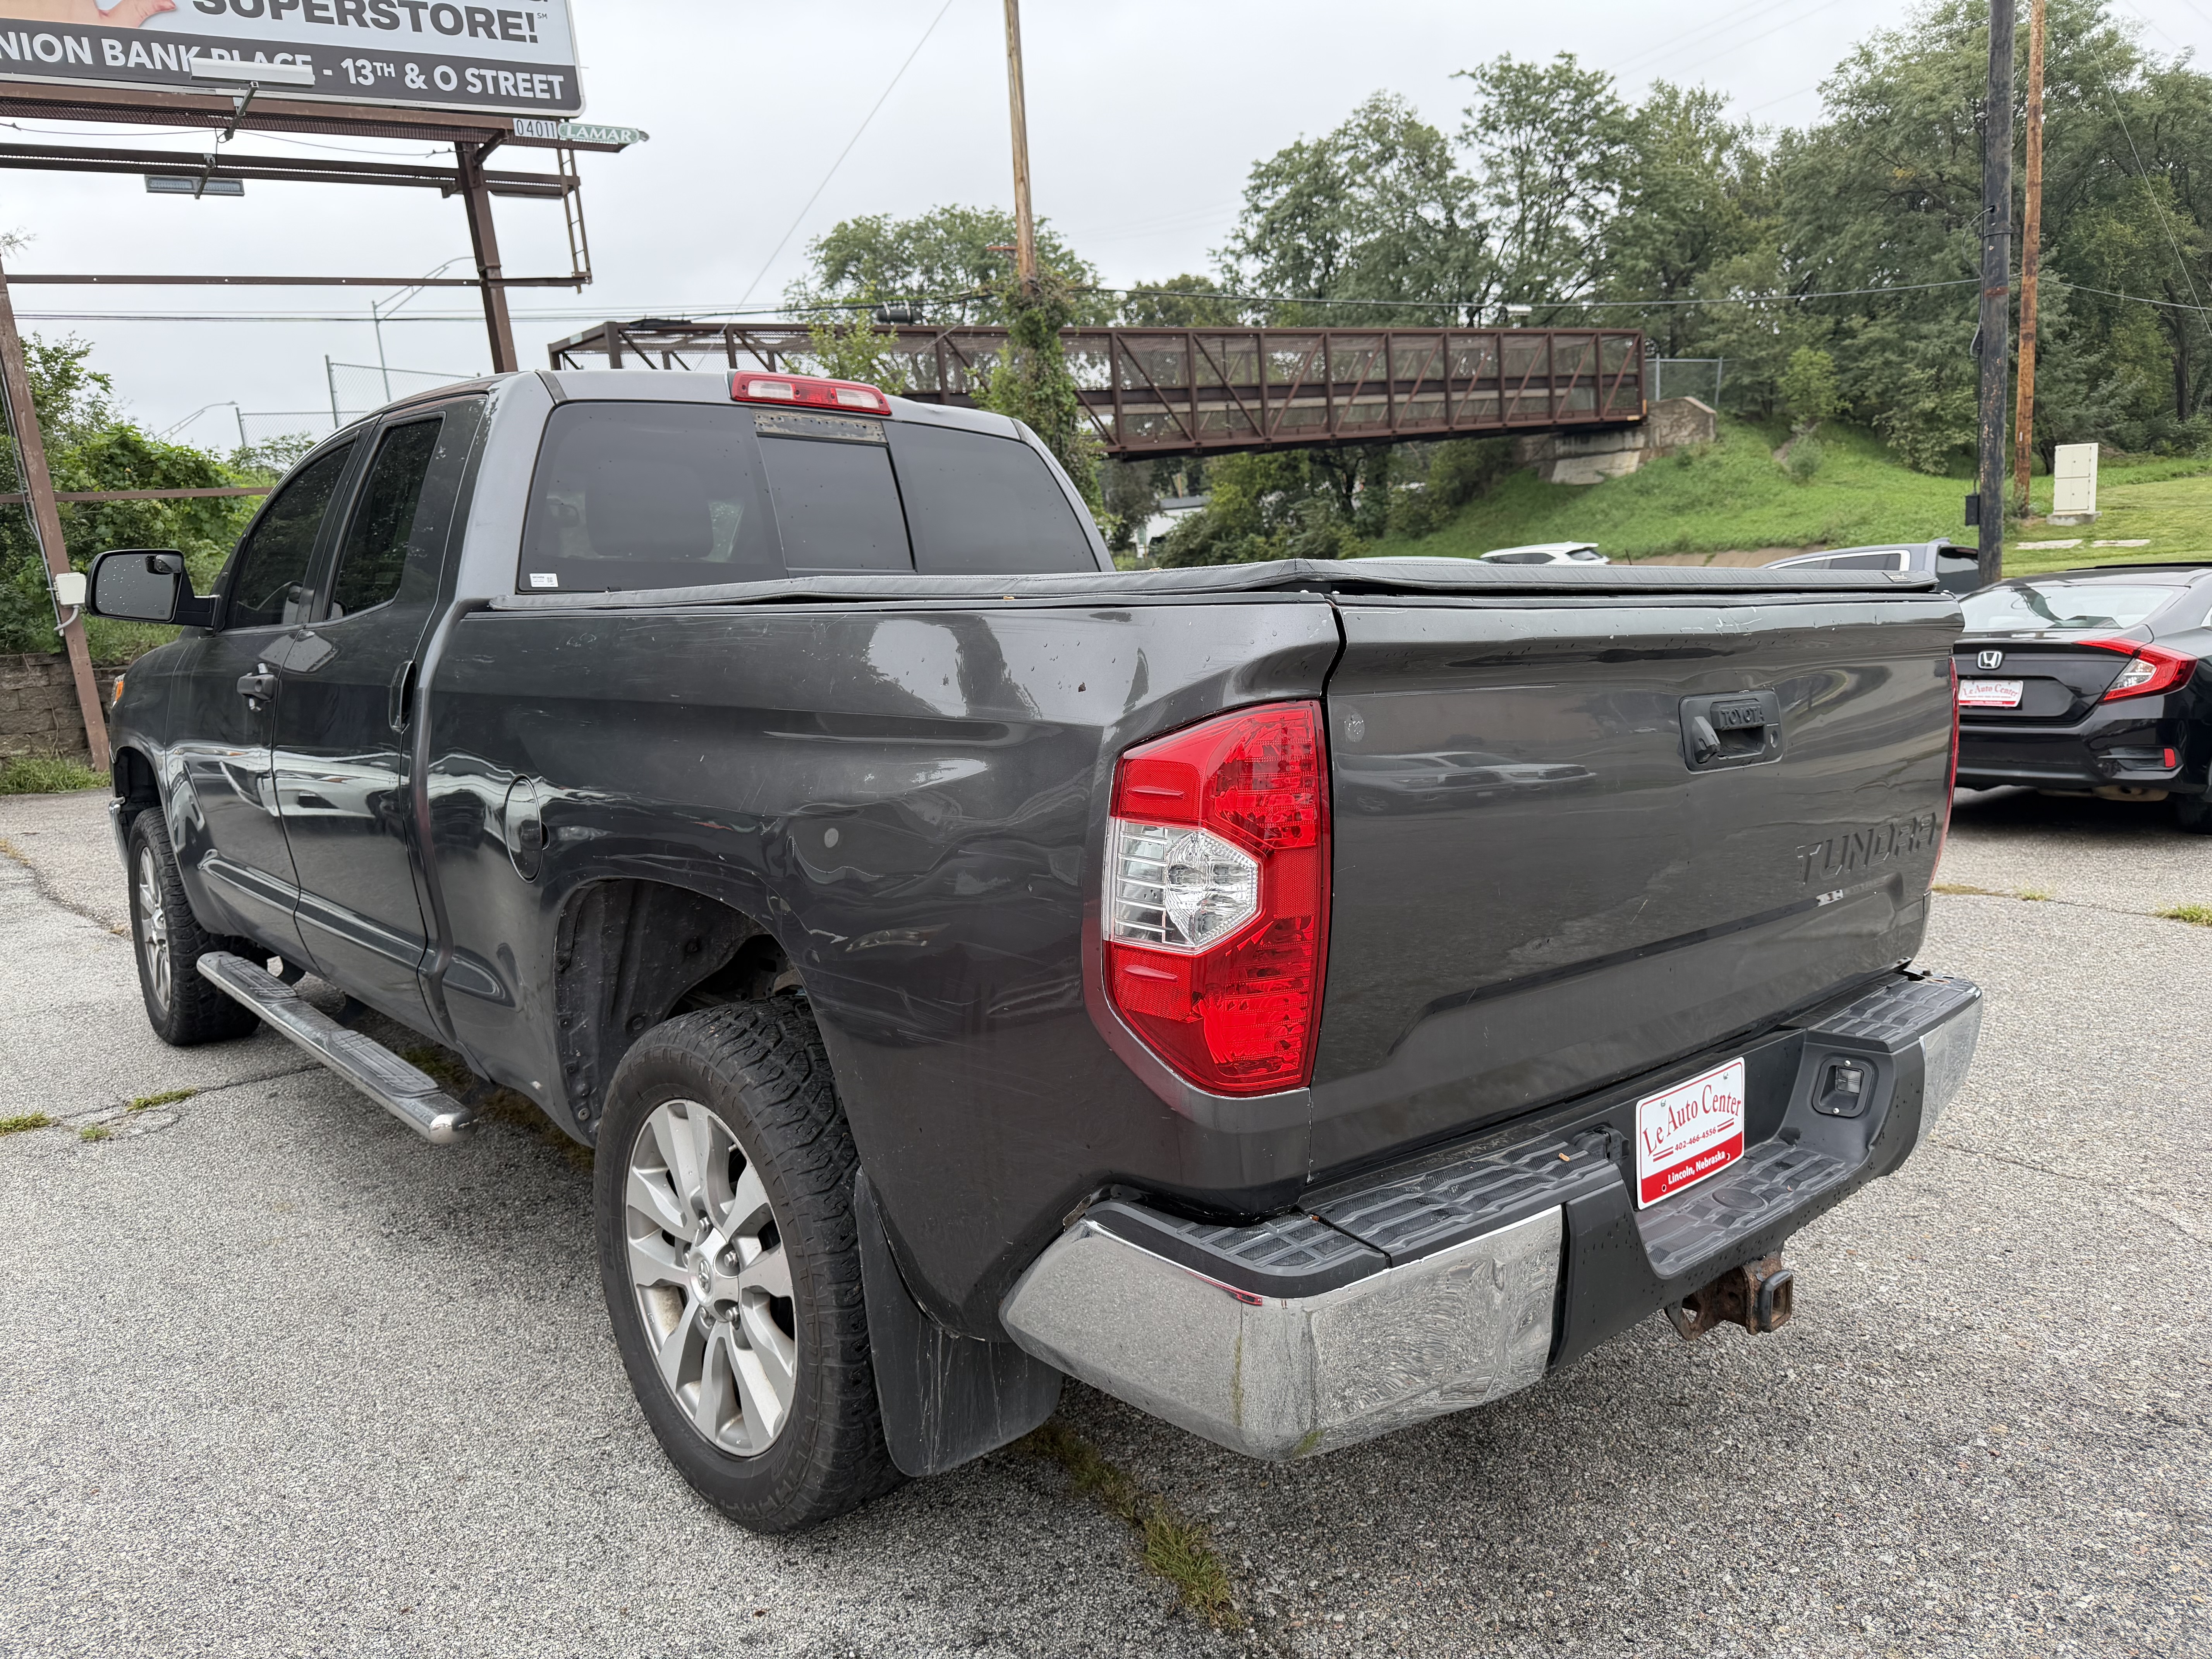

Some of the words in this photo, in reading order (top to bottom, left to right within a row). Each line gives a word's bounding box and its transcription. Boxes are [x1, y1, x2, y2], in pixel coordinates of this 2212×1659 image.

[101, 38, 201, 72] BANK
[340, 58, 395, 86] 13TH
[405, 63, 428, 89] &
[433, 65, 458, 91] O
[465, 67, 564, 100] STREET
[517, 119, 555, 138] 04011
[567, 125, 632, 141] LAMAR
[1975, 684, 1992, 693] Auto
[1994, 684, 2018, 697] Center
[1721, 706, 1765, 726] TOYOTA
[1795, 812, 1936, 887] TUNDRA
[1643, 1126, 1664, 1157] Le
[1666, 1099, 1698, 1137] Auto
[1702, 1084, 1741, 1116] Center
[1674, 1127, 1717, 1152] 402-466-4556
[1668, 1165, 1695, 1185] Lincoln,
[1695, 1151, 1726, 1171] Nebraska
